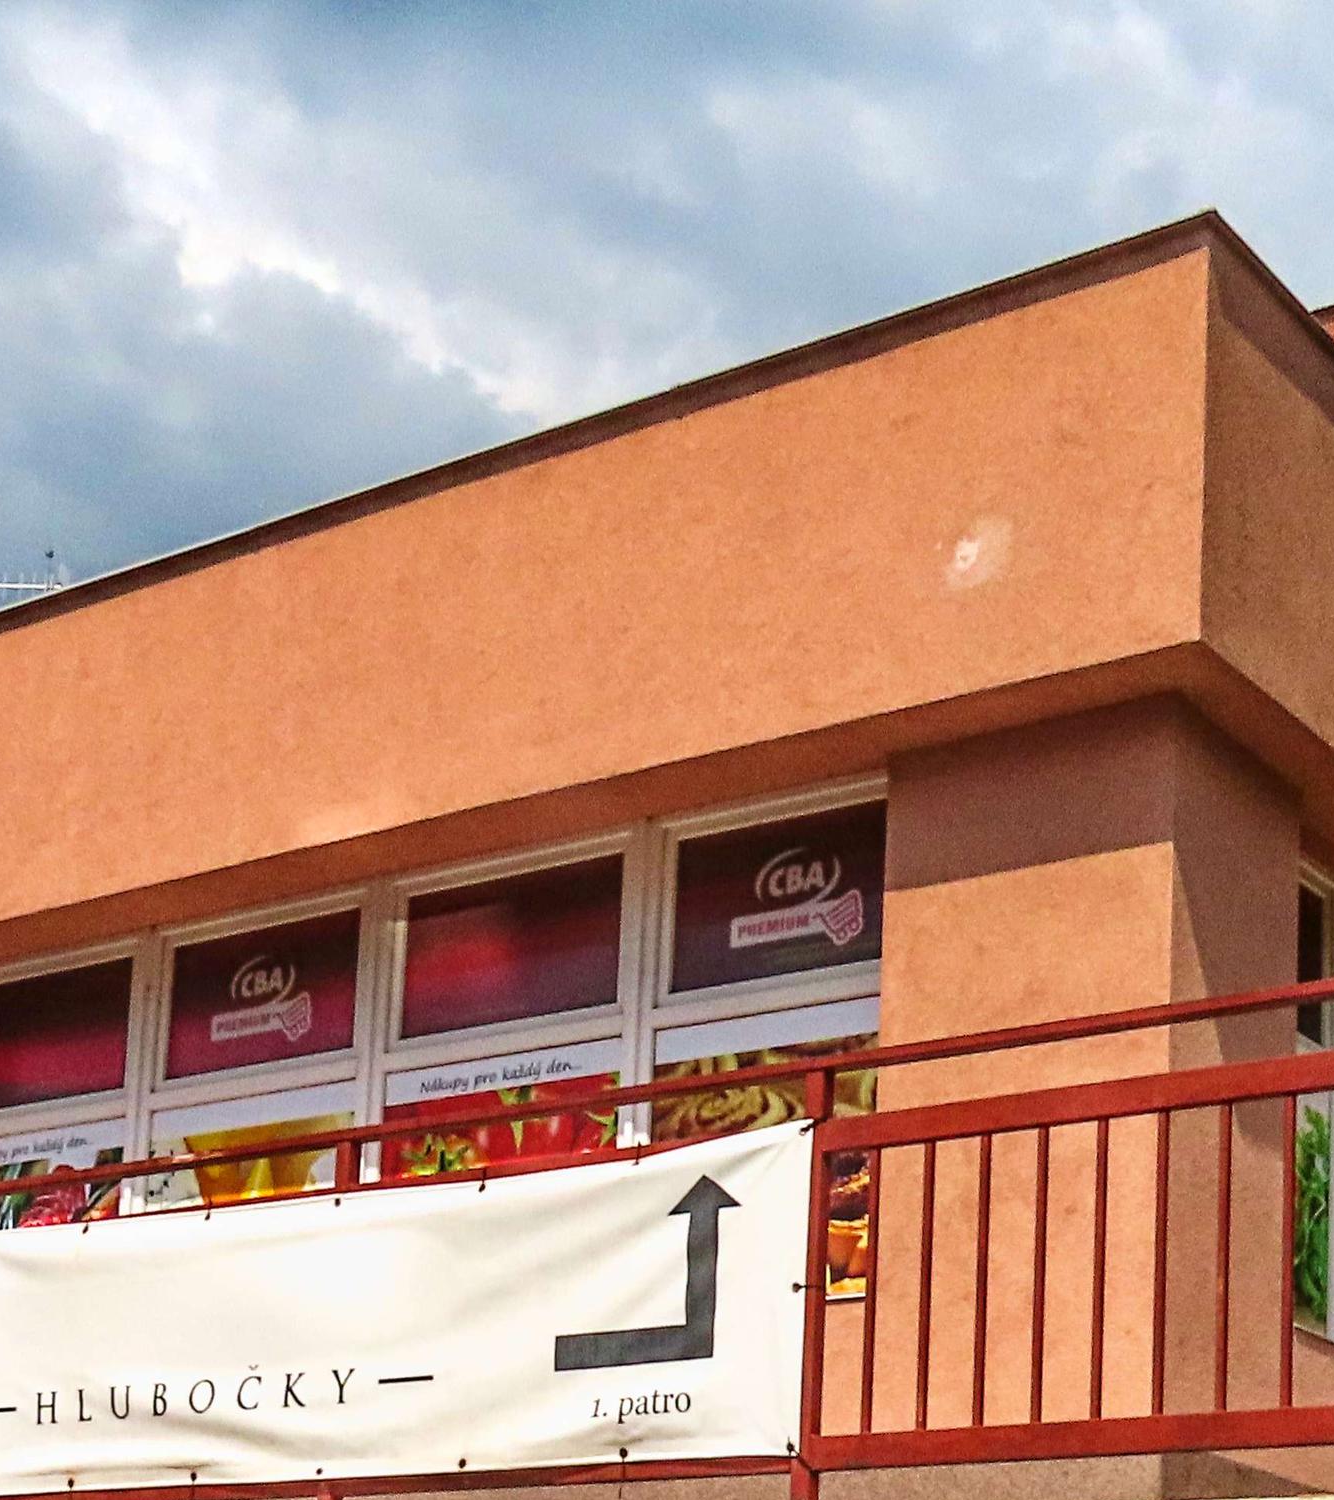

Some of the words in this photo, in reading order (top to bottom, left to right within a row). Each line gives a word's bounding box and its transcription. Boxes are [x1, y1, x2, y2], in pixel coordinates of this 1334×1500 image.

[769, 861, 826, 897] CBA
[737, 914, 810, 939] PREMIUM
[241, 966, 285, 998] CBA
[419, 1076, 469, 1094] Nákupy
[473, 1071, 498, 1089] pro
[35, 1364, 356, 1426] HLUBOČKY
[590, 1398, 608, 1418] 1.
[617, 1389, 692, 1425] patro
